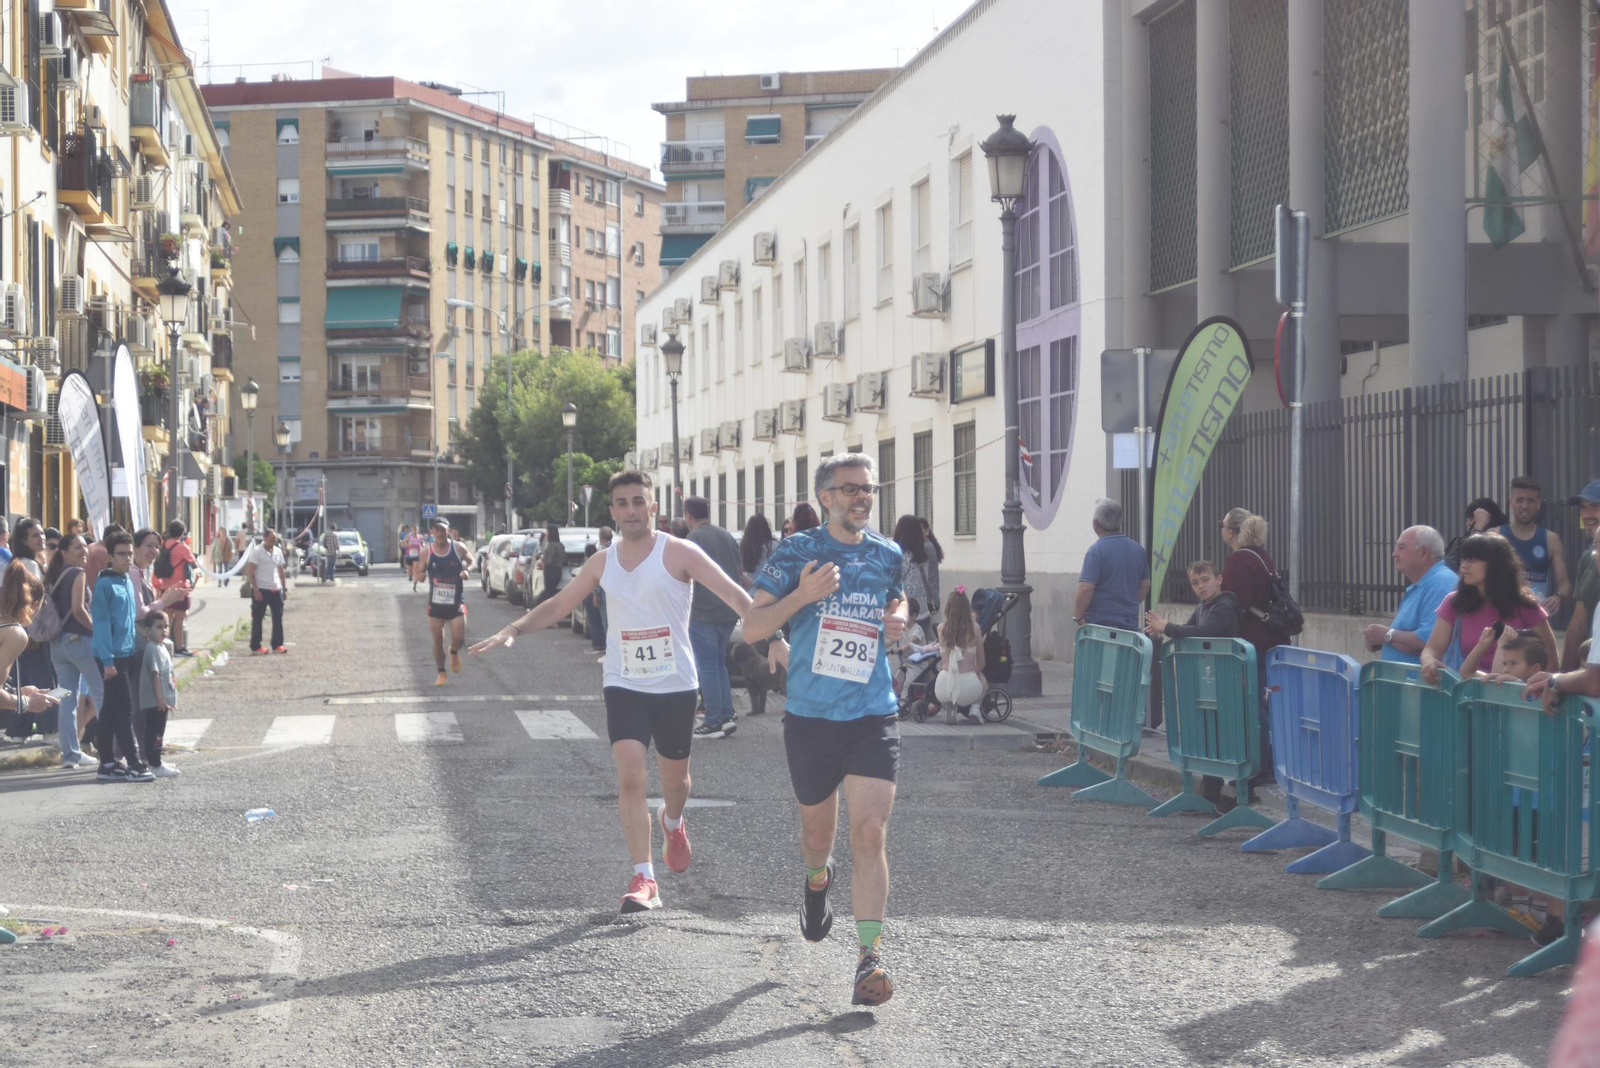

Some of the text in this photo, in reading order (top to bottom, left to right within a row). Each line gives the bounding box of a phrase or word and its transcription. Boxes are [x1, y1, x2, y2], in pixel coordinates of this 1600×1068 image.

[762, 563, 782, 580] ECO
[841, 592, 878, 606] MEDIA
[815, 601, 840, 616] 38
[635, 645, 657, 661] 41
[830, 638, 868, 662] 298
